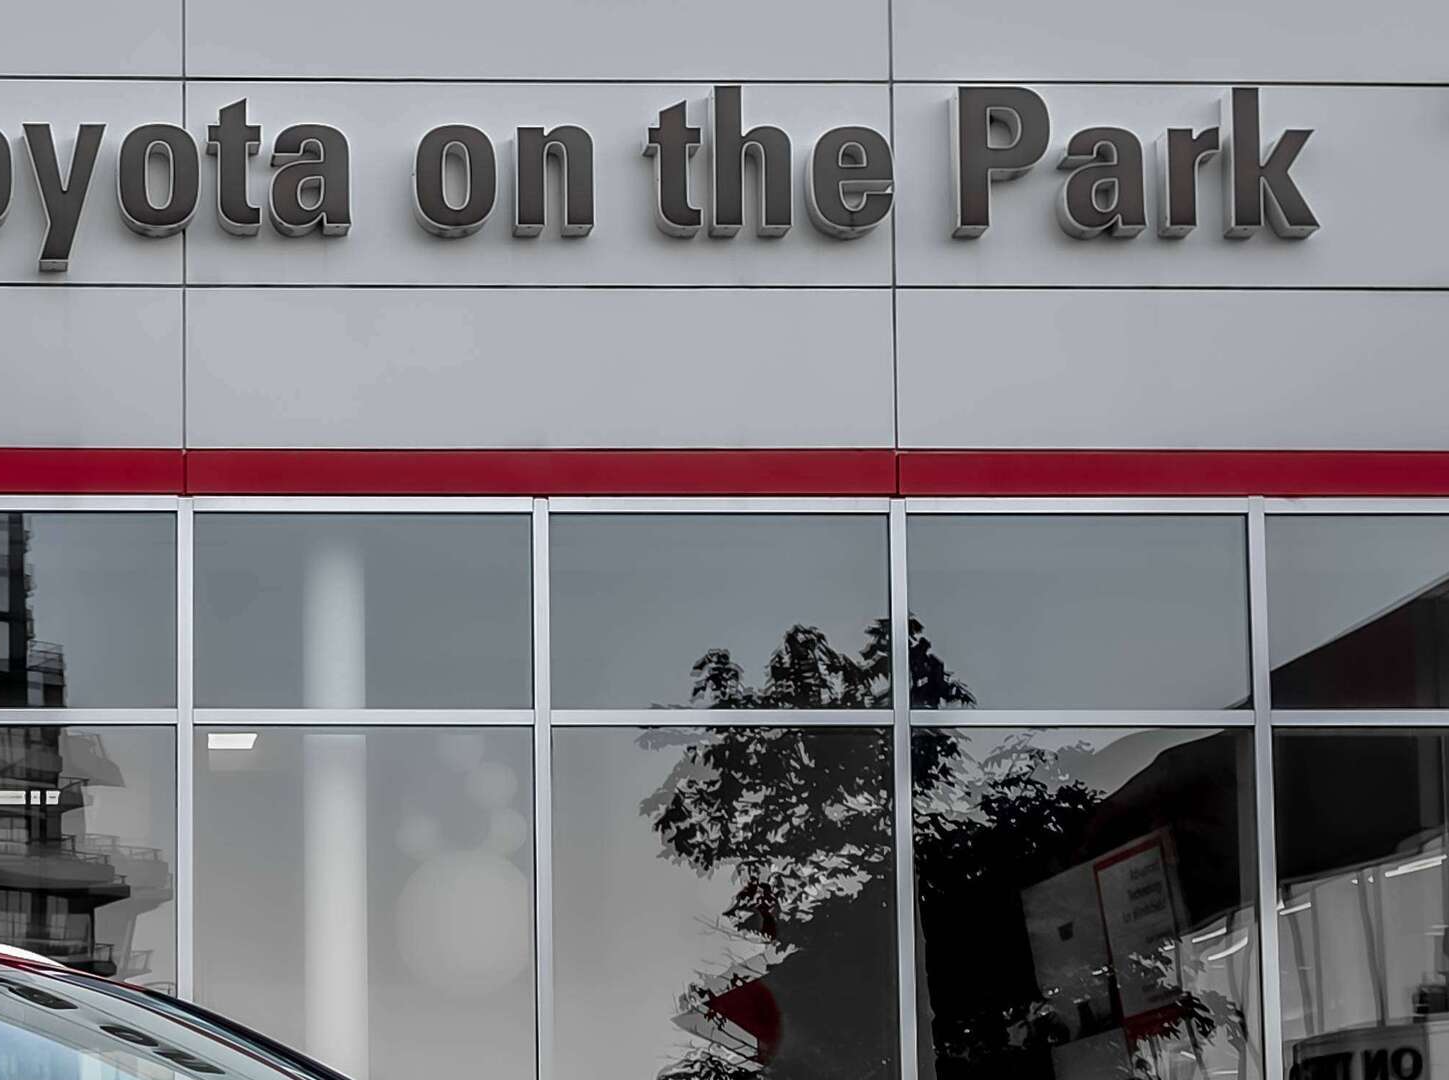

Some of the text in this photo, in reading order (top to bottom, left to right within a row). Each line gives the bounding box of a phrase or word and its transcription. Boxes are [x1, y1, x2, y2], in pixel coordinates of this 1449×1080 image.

[414, 123, 596, 243] on
[643, 84, 895, 243] the
[949, 85, 1322, 243] Park
